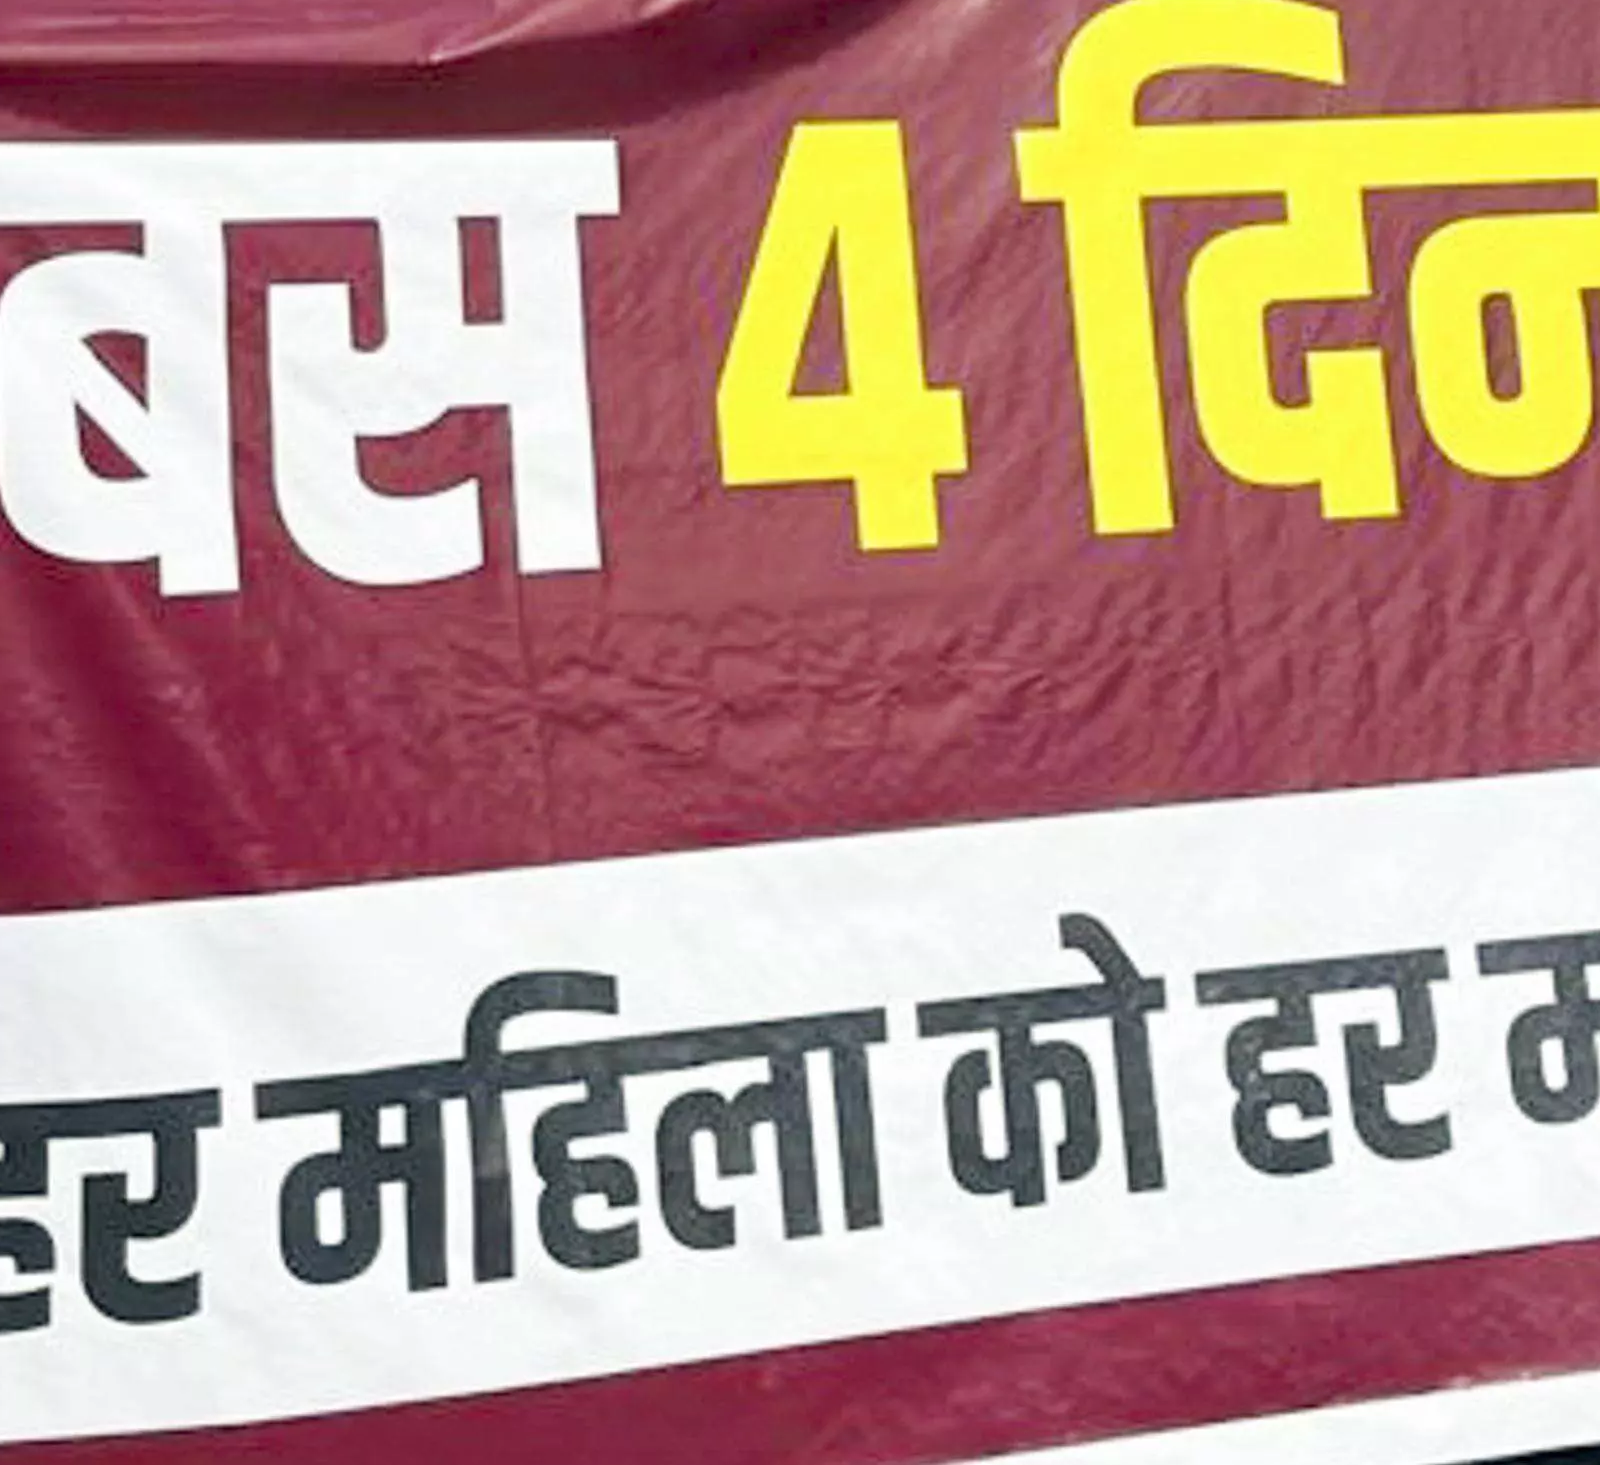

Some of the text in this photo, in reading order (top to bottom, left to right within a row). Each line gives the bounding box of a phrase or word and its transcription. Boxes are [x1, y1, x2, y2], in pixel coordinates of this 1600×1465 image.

[715, 119, 968, 552] 4
[254, 970, 888, 1293] महिला
[915, 912, 1167, 1209] को
[1195, 948, 1452, 1176] हर
